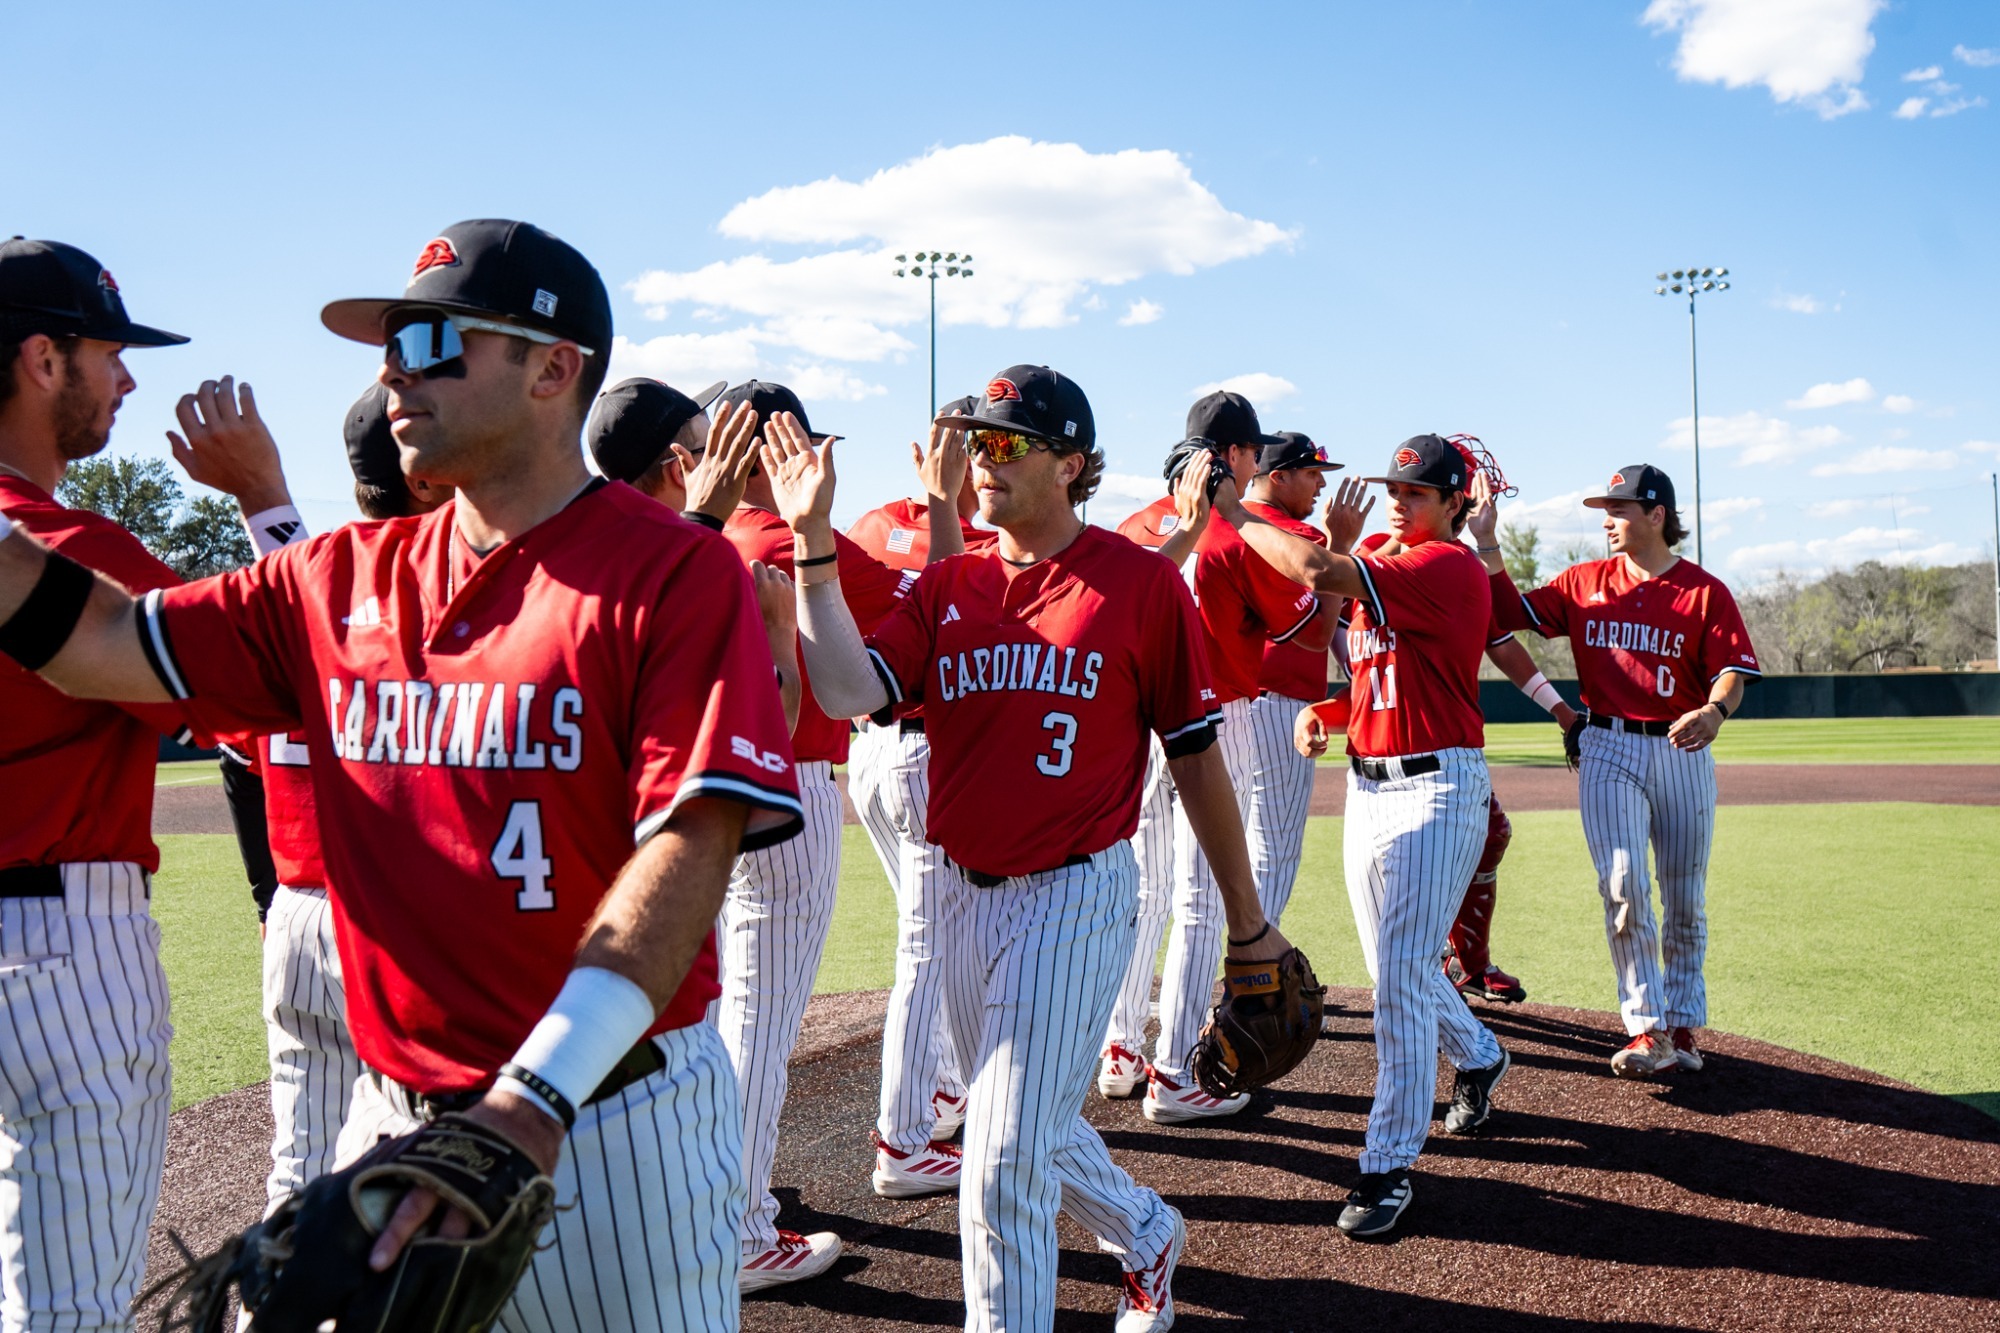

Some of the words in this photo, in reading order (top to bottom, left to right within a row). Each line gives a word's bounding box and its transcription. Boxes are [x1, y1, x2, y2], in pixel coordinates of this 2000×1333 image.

[1585, 619, 1685, 658] CARDINALS
[937, 643, 1104, 702] CARDINALS
[1199, 687, 1217, 701] SL
[1368, 663, 1397, 711] 11
[1656, 664, 1676, 698] 0
[328, 677, 584, 772] CARDINALS
[1035, 711, 1079, 778] 3
[730, 735, 787, 774] SLC
[489, 800, 556, 911] 4
[1231, 973, 1272, 987] Wilson
